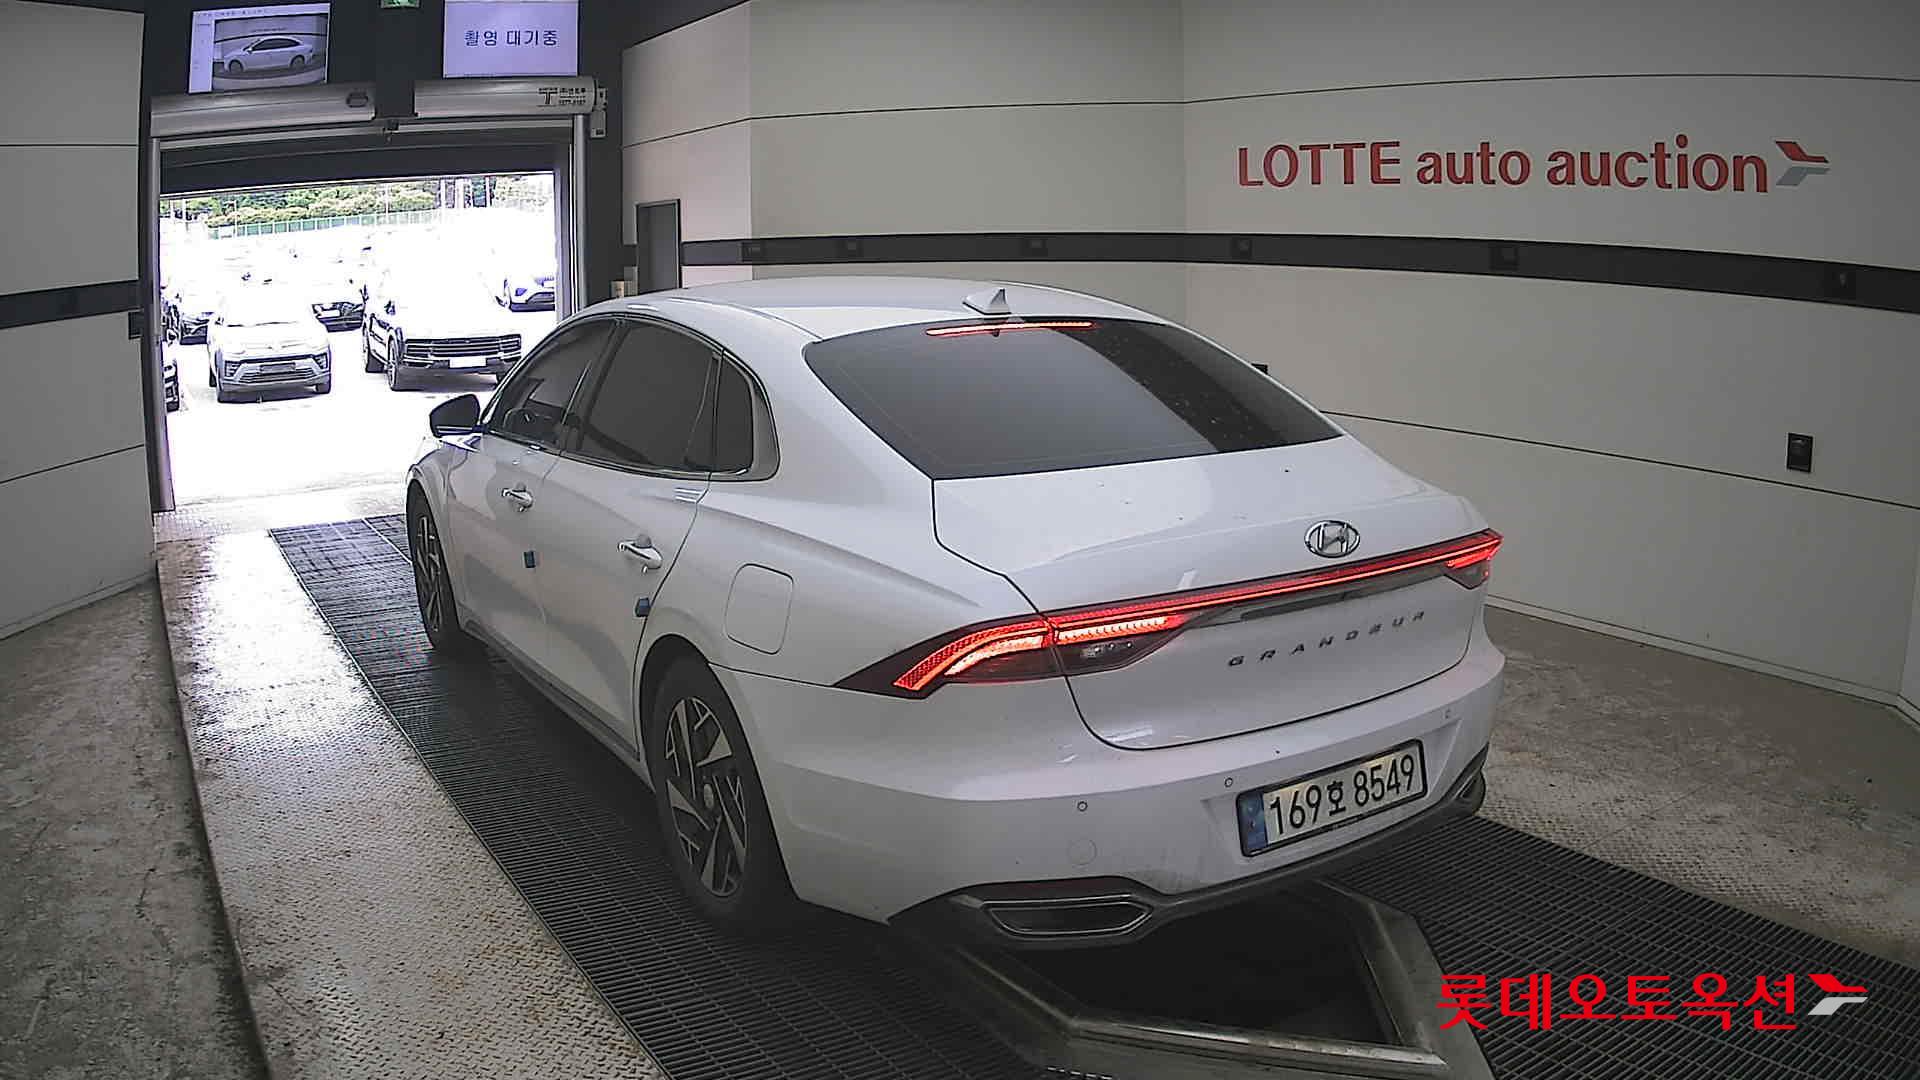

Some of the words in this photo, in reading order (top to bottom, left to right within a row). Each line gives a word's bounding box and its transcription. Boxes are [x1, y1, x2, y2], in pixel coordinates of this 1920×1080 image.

[464, 29, 498, 47] 촬영
[506, 29, 558, 47] 대기중
[1238, 140, 1401, 188] LOTTE
[1416, 141, 1532, 186] auto
[1546, 133, 1767, 193] auction
[1228, 610, 1424, 667] GRANDEUR
[1269, 780, 1347, 835] 169호
[1353, 754, 1415, 808] 8549
